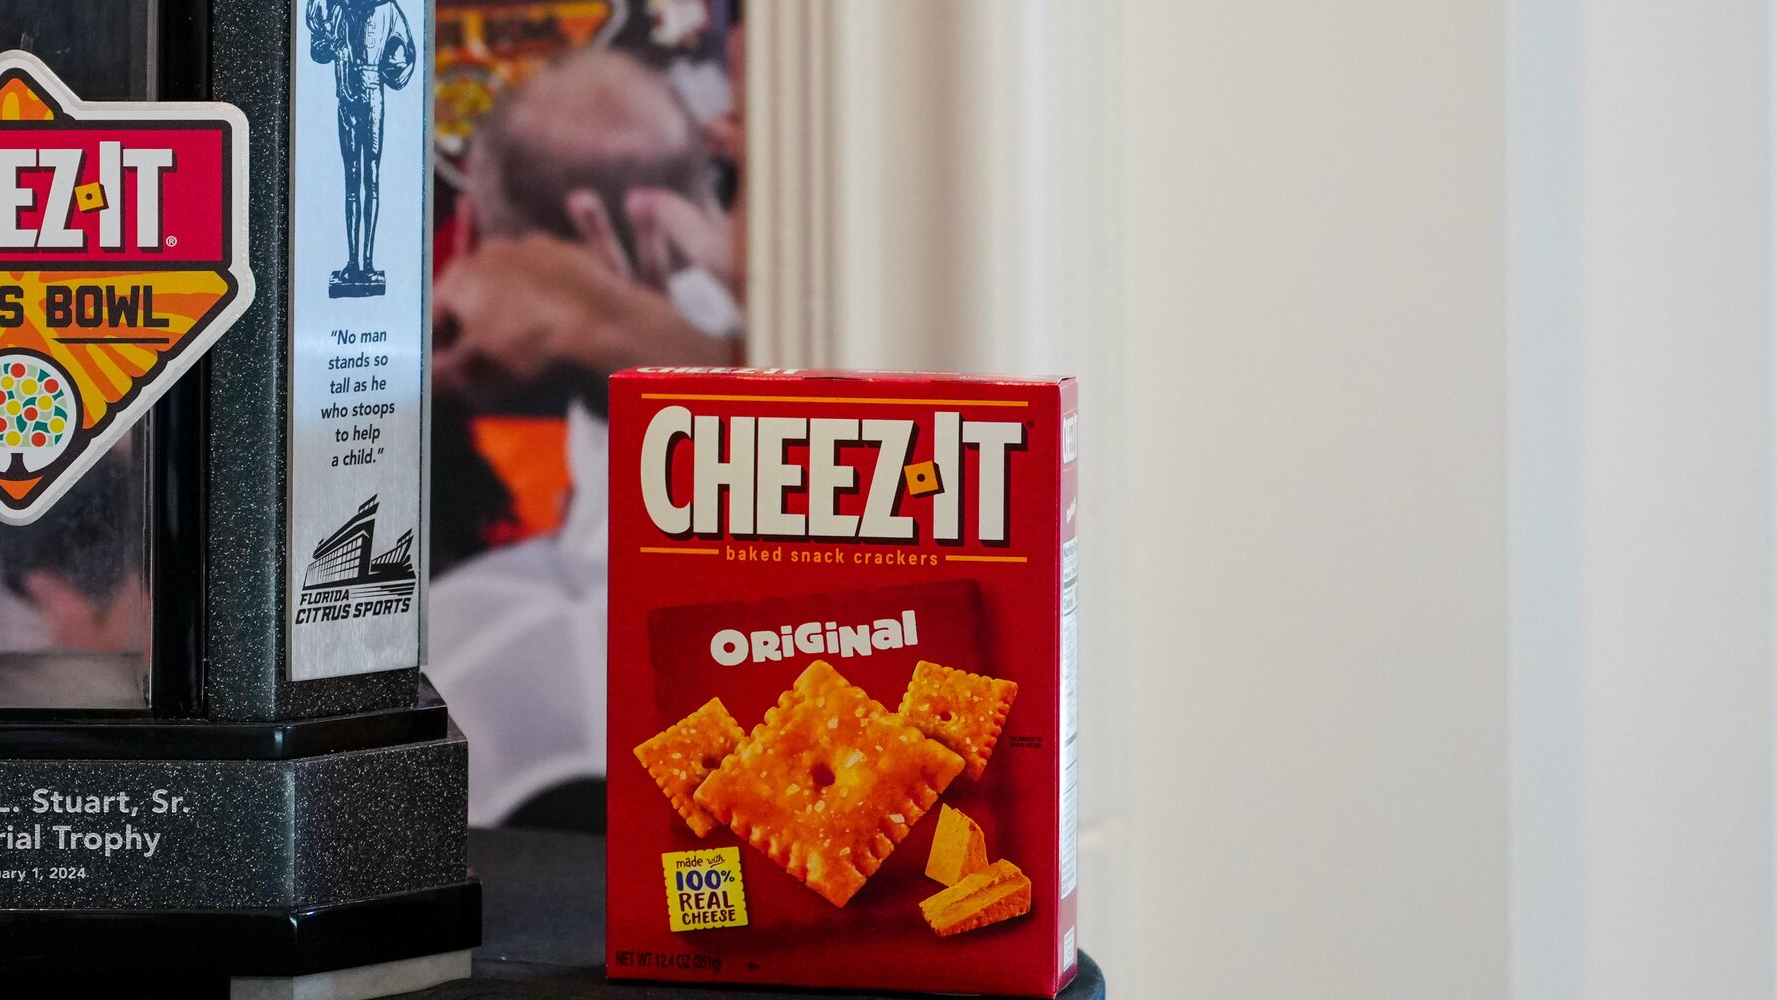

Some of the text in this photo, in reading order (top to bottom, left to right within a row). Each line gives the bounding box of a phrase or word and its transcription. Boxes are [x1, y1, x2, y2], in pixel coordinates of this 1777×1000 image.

[46, 285, 170, 328] BOWL
[360, 331, 387, 343] man
[328, 352, 388, 370] stands so
[330, 376, 386, 394] tall as he
[321, 402, 395, 419] who stoops
[335, 424, 380, 443] to help
[331, 455, 339, 467] a
[726, 545, 939, 566] baked snack crackers
[300, 589, 350, 606] FLORIDA
[295, 598, 411, 625] CITRUS SPORTS
[32, 788, 139, 817] Stuart,
[151, 788, 189, 813] Sr.
[52, 825, 161, 858] Trophy
[676, 854, 725, 869] made with
[32, 867, 44, 881] 1,
[49, 867, 86, 880] 2024
[676, 870, 735, 891] 100%
[679, 891, 734, 912] REAL
[682, 909, 736, 925] CHEESE
[615, 951, 634, 966] NET
[637, 952, 652, 966] WT
[676, 953, 691, 969] OZ
